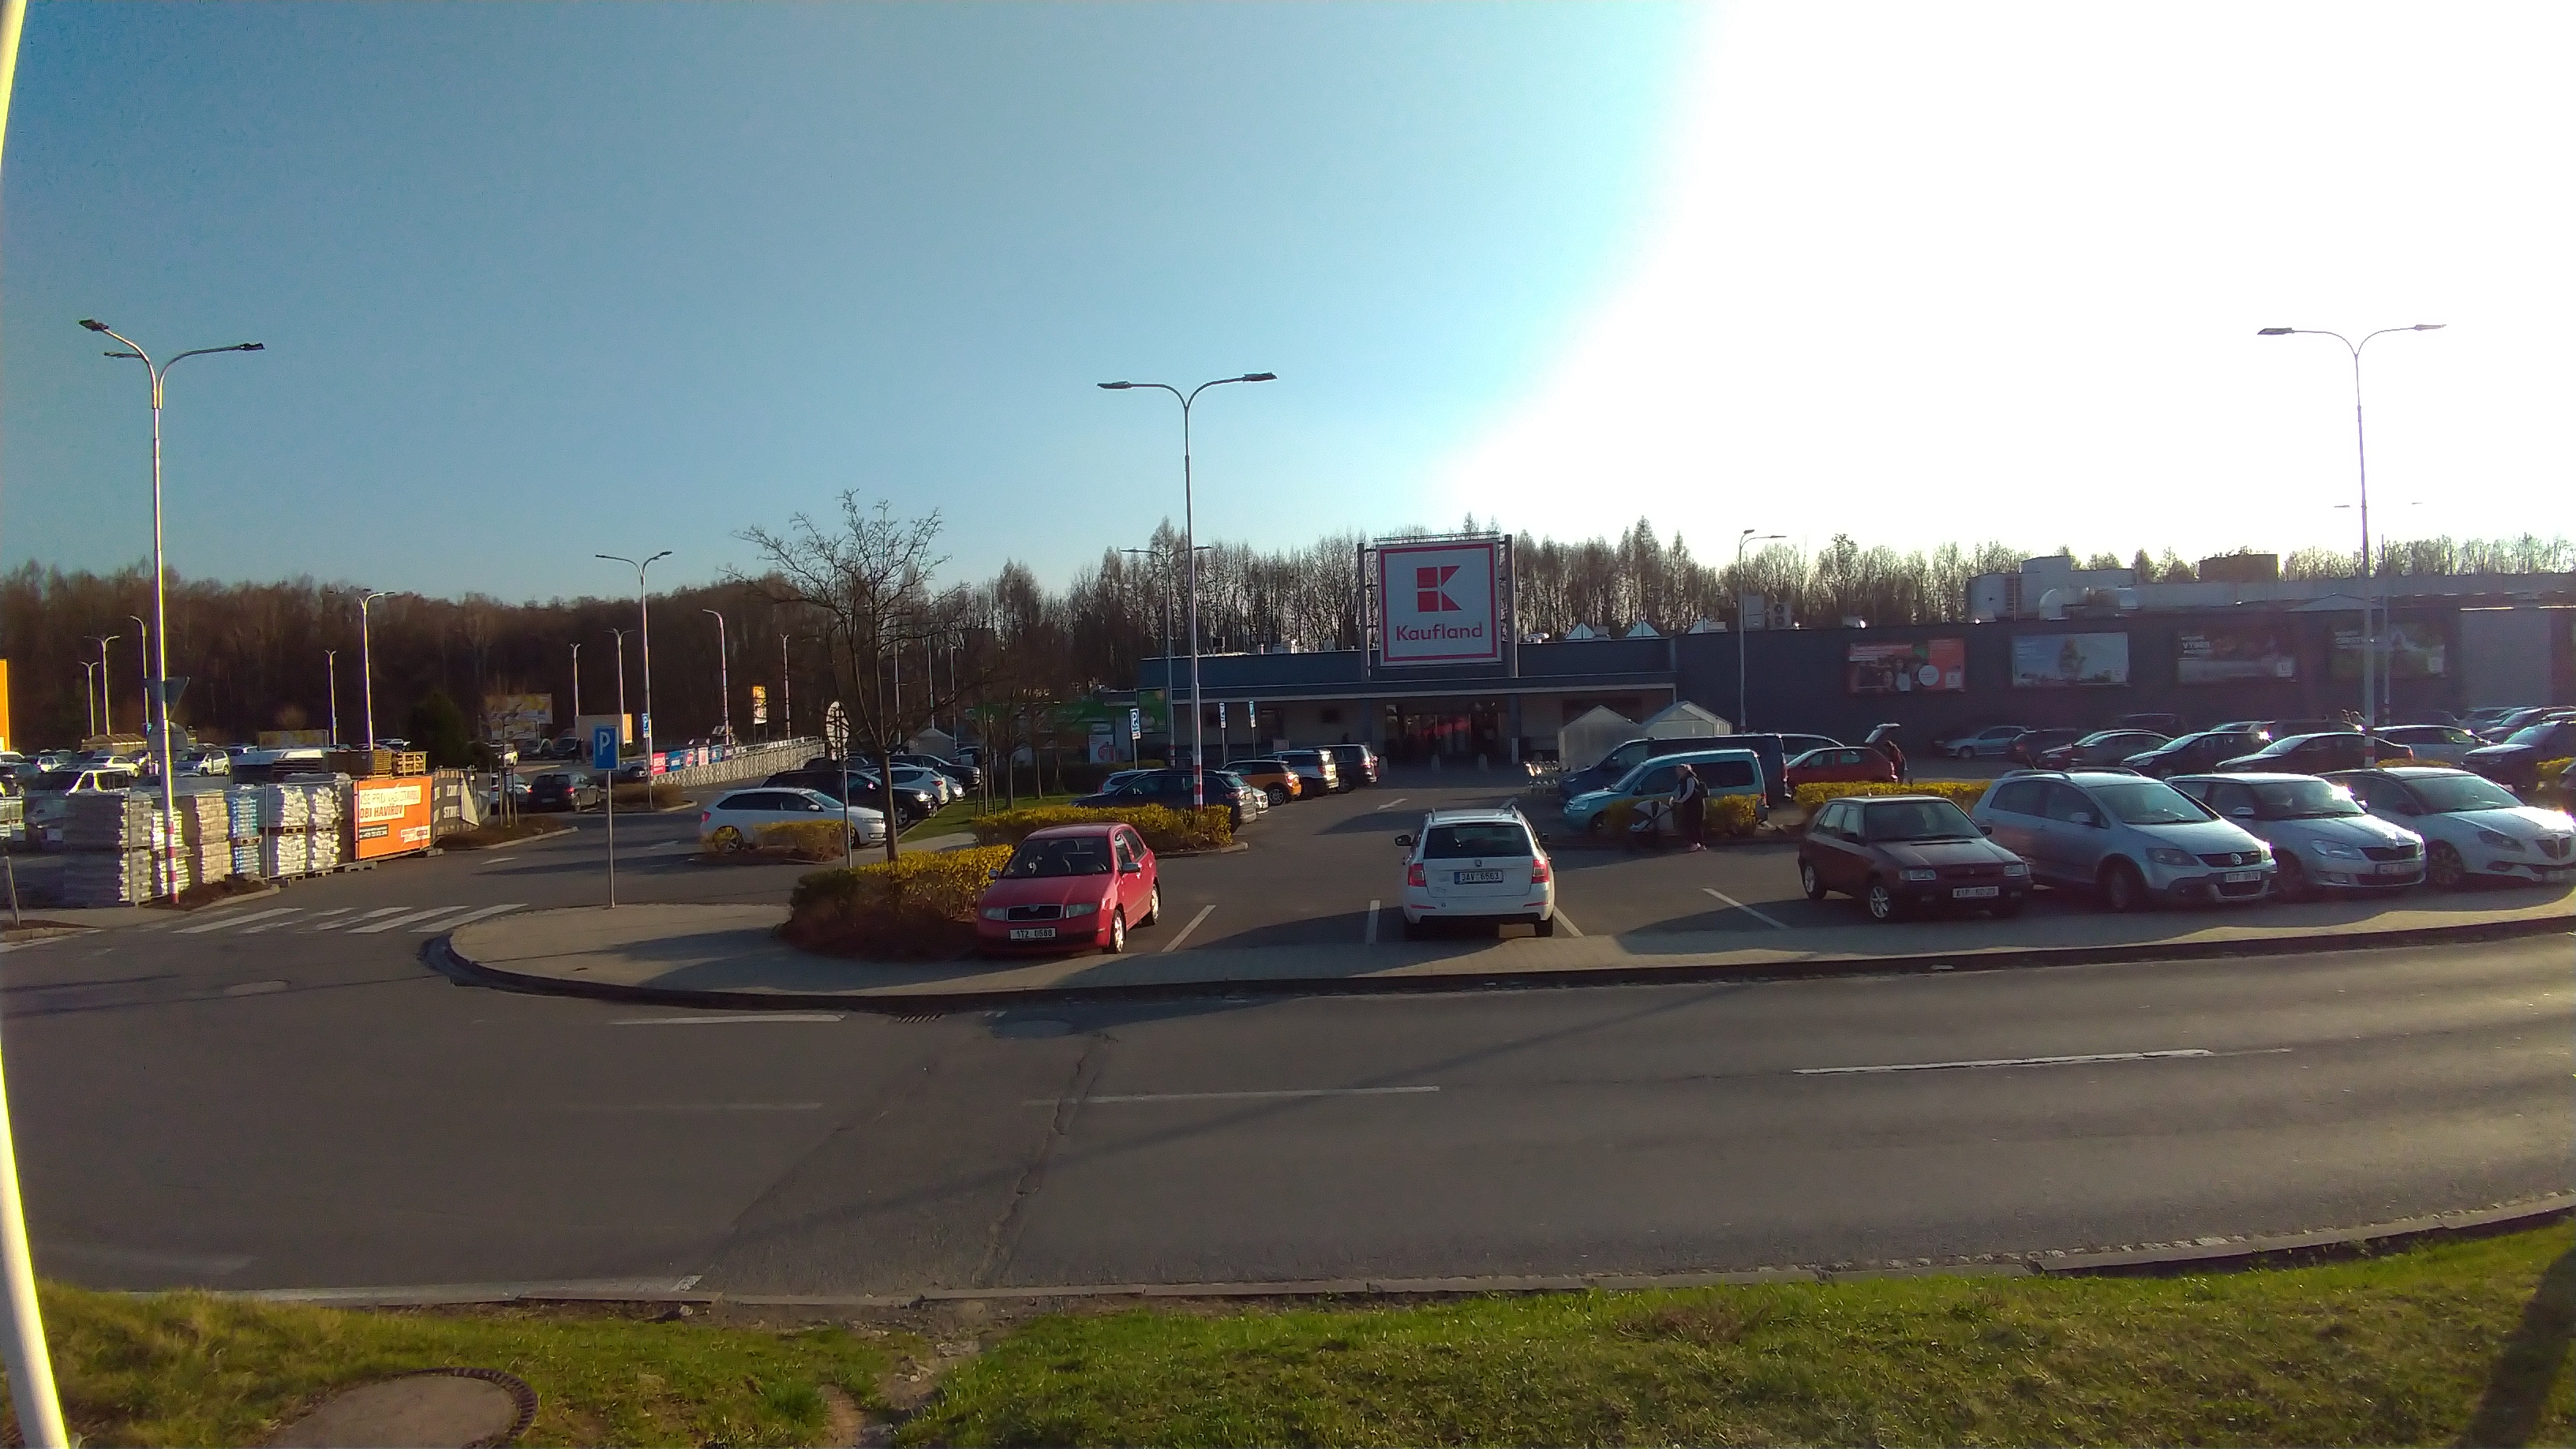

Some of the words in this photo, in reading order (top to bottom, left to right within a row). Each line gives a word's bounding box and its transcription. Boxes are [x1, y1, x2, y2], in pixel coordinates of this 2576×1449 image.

[1396, 622, 1483, 641] Kaufland
[599, 731, 611, 756] P
[360, 807, 373, 818] OBI
